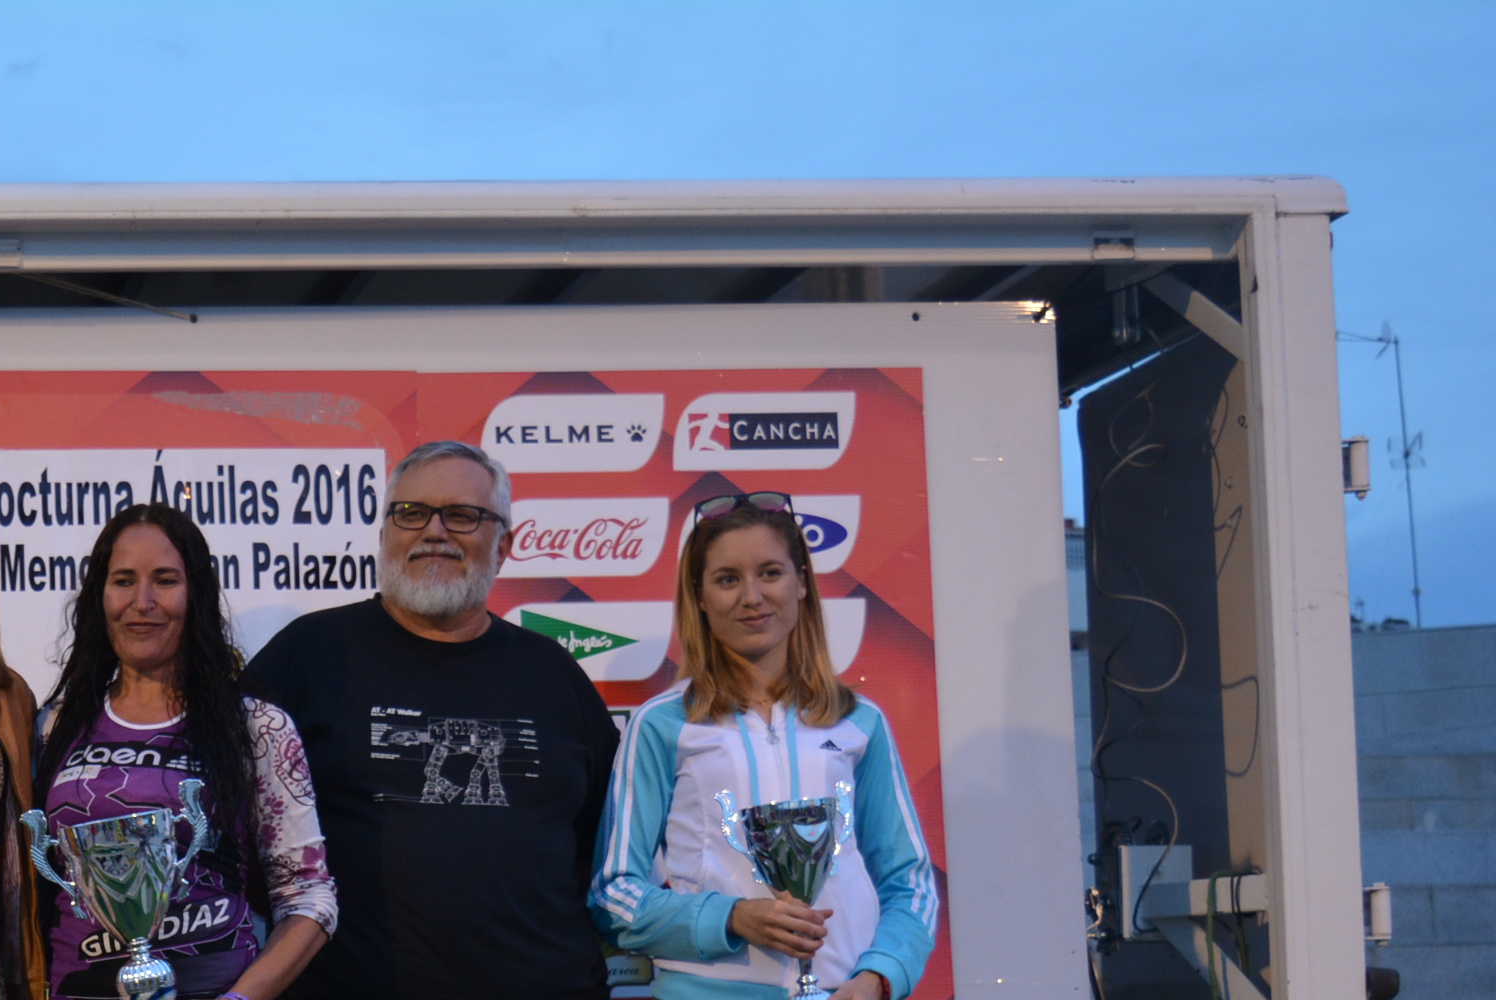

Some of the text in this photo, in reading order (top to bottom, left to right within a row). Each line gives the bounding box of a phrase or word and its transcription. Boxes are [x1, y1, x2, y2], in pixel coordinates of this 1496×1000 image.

[494, 424, 615, 444] KELME
[732, 420, 837, 441] CANCHA
[292, 464, 378, 526] 2016
[508, 517, 648, 562] Coca-Cola
[252, 541, 377, 591] Palazón
[158, 898, 230, 940] DÍAZ
